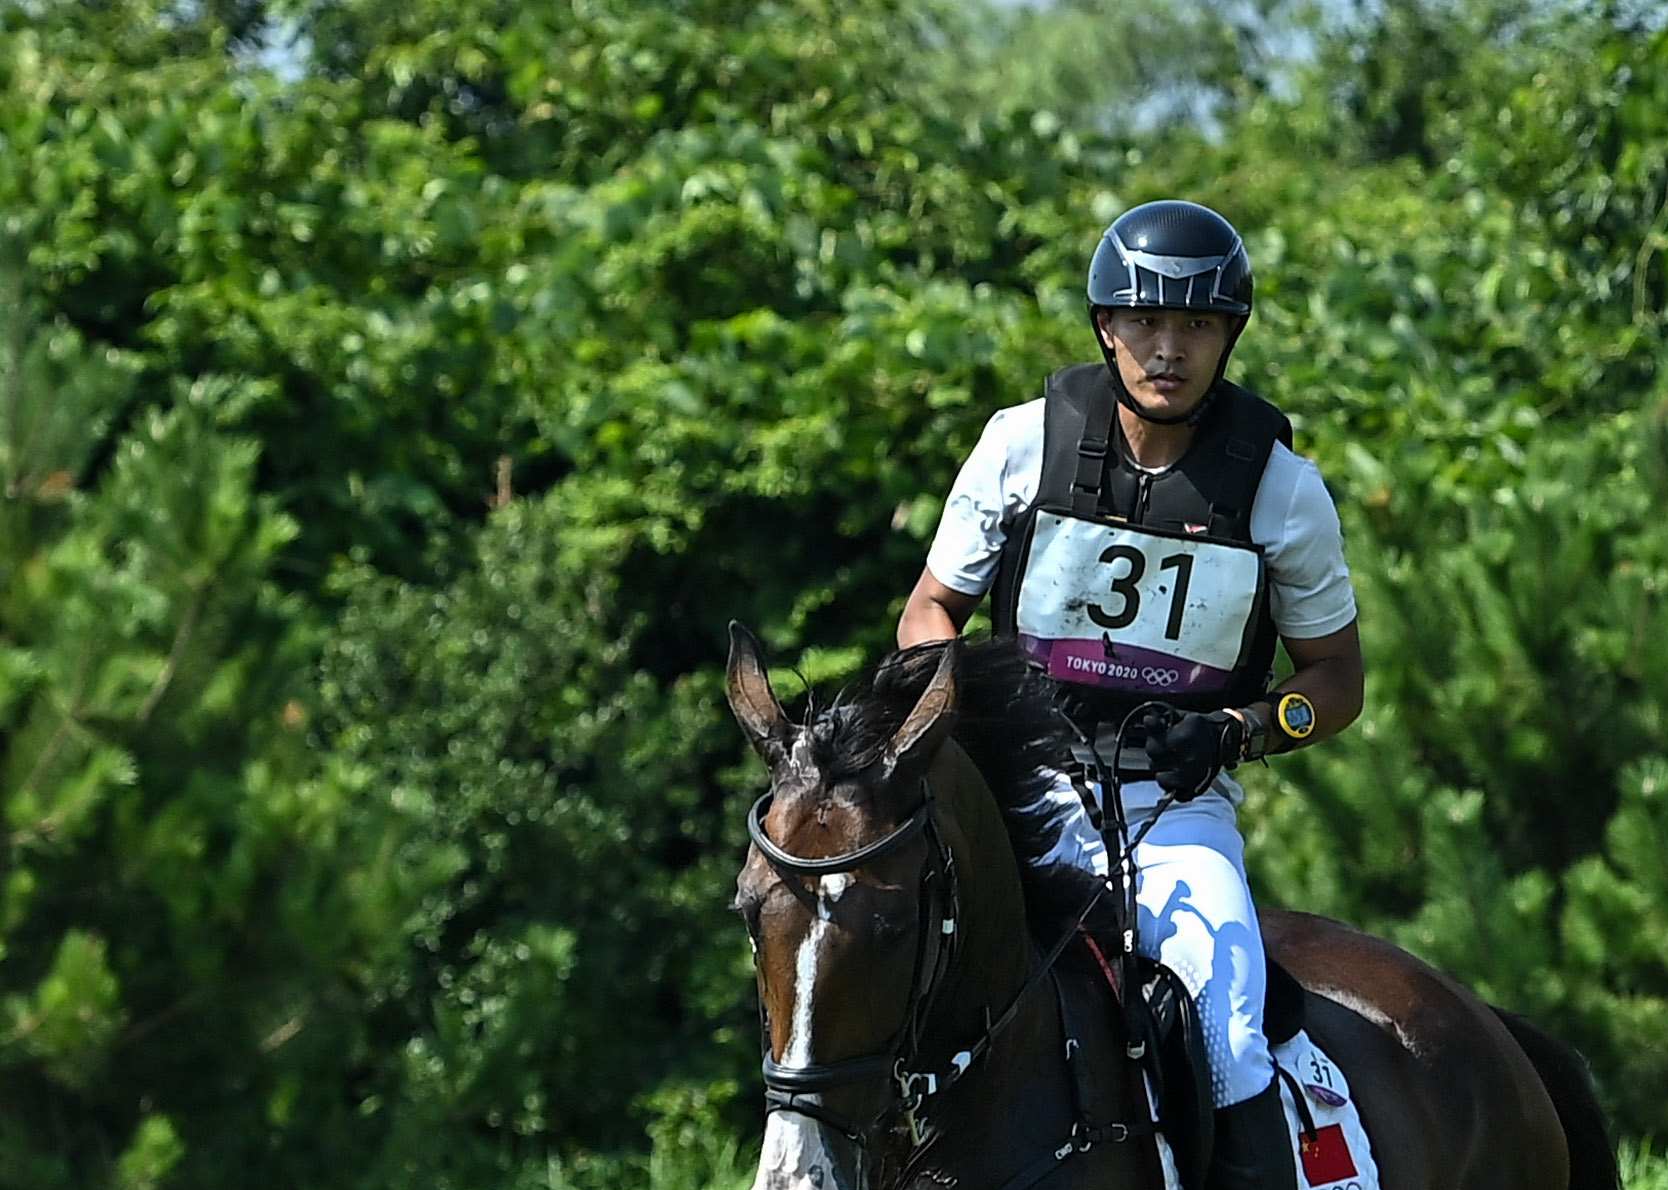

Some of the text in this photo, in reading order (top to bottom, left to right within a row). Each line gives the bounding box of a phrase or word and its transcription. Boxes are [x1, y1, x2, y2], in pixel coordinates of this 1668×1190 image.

[1086, 544, 1195, 641] 31
[1066, 655, 1138, 680] TOKYO 2020
